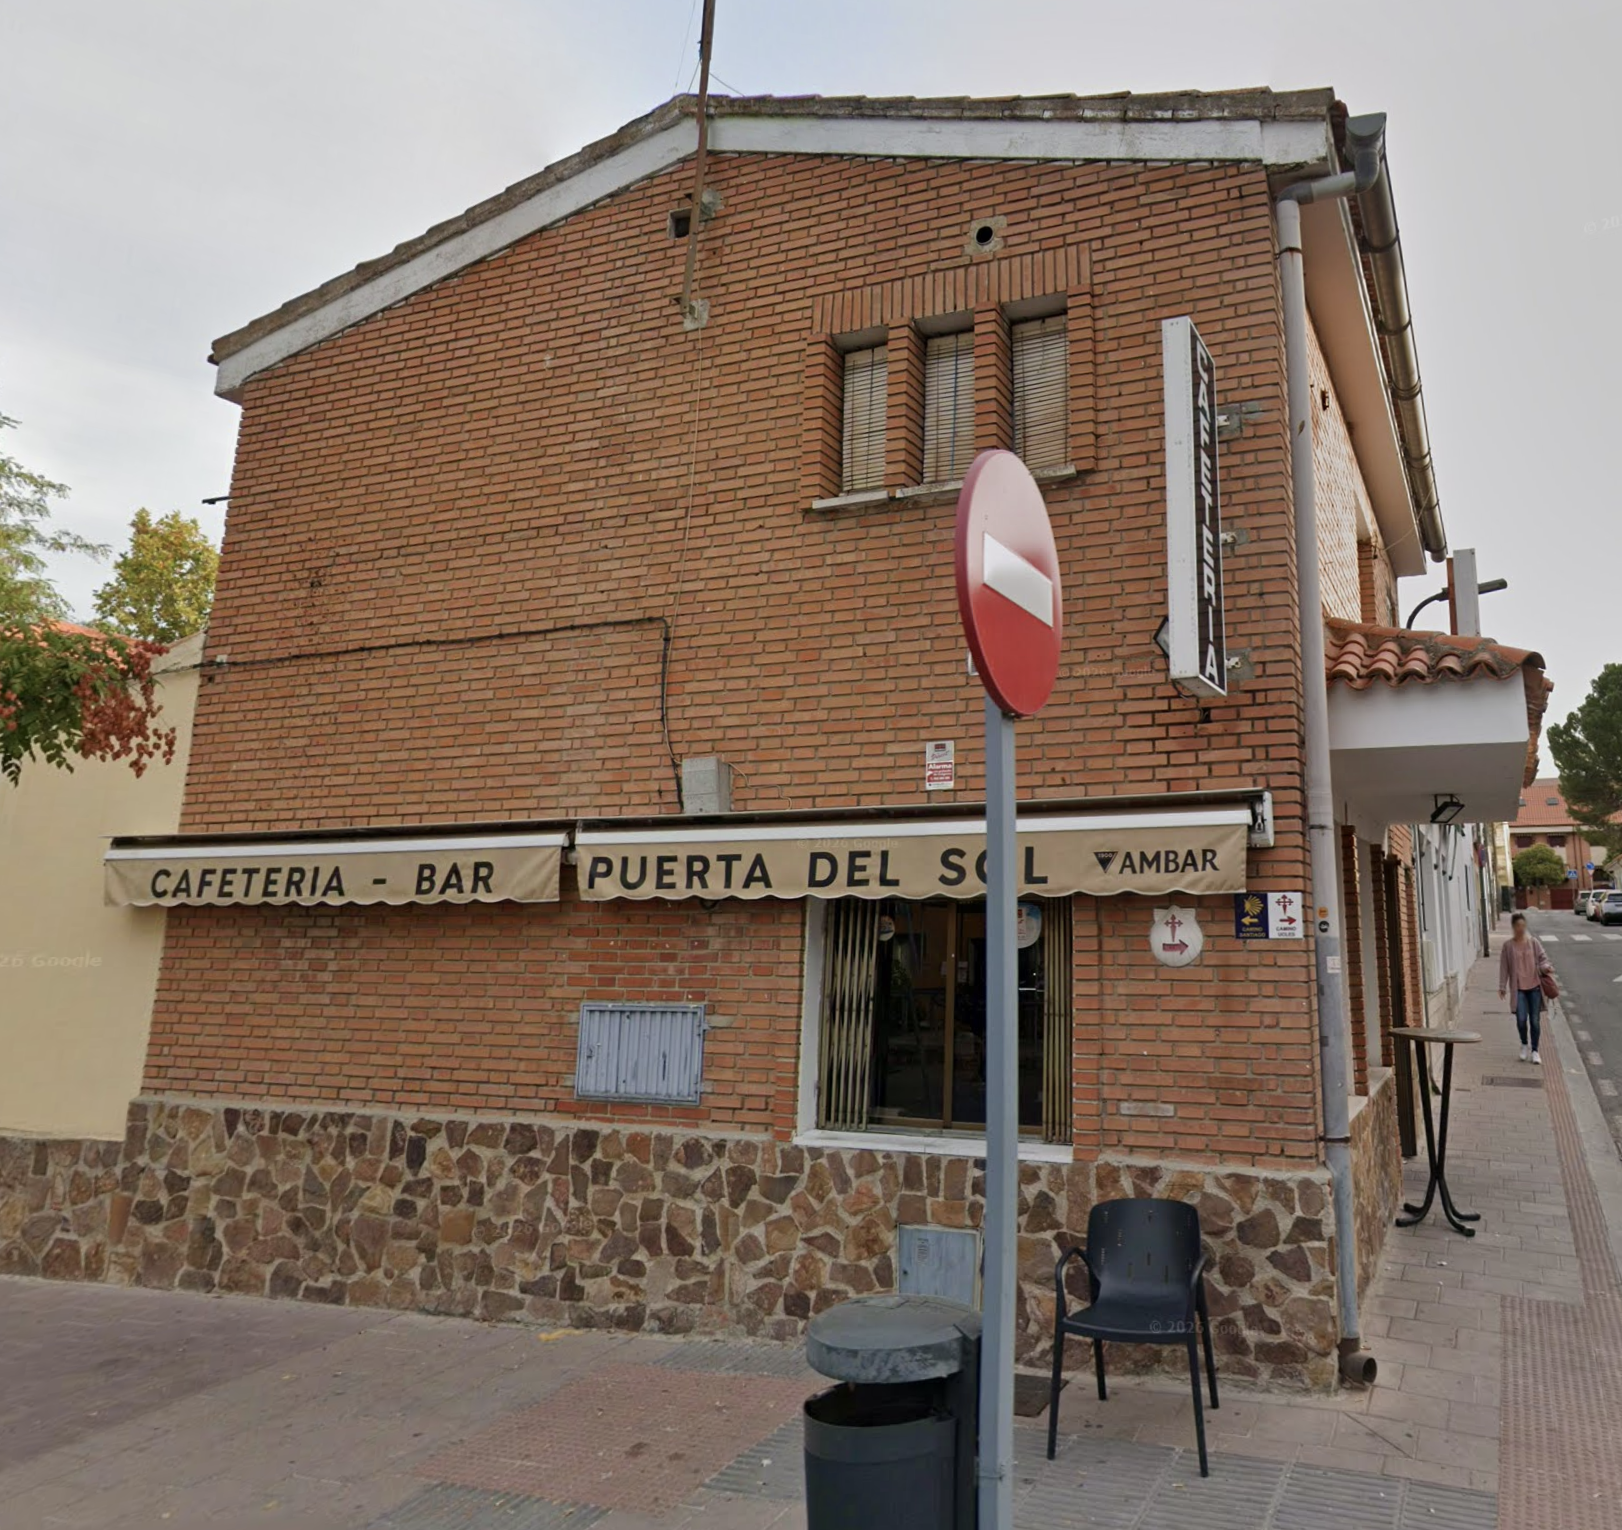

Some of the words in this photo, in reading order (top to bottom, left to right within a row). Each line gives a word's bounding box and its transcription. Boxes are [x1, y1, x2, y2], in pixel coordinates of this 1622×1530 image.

[1196, 339, 1219, 685] CAFETERIA
[151, 866, 345, 898] CAFETERIA
[415, 861, 494, 895] BAR
[588, 853, 773, 890] PUERTA
[808, 850, 900, 887] DEL
[1119, 849, 1219, 874] AMBAR
